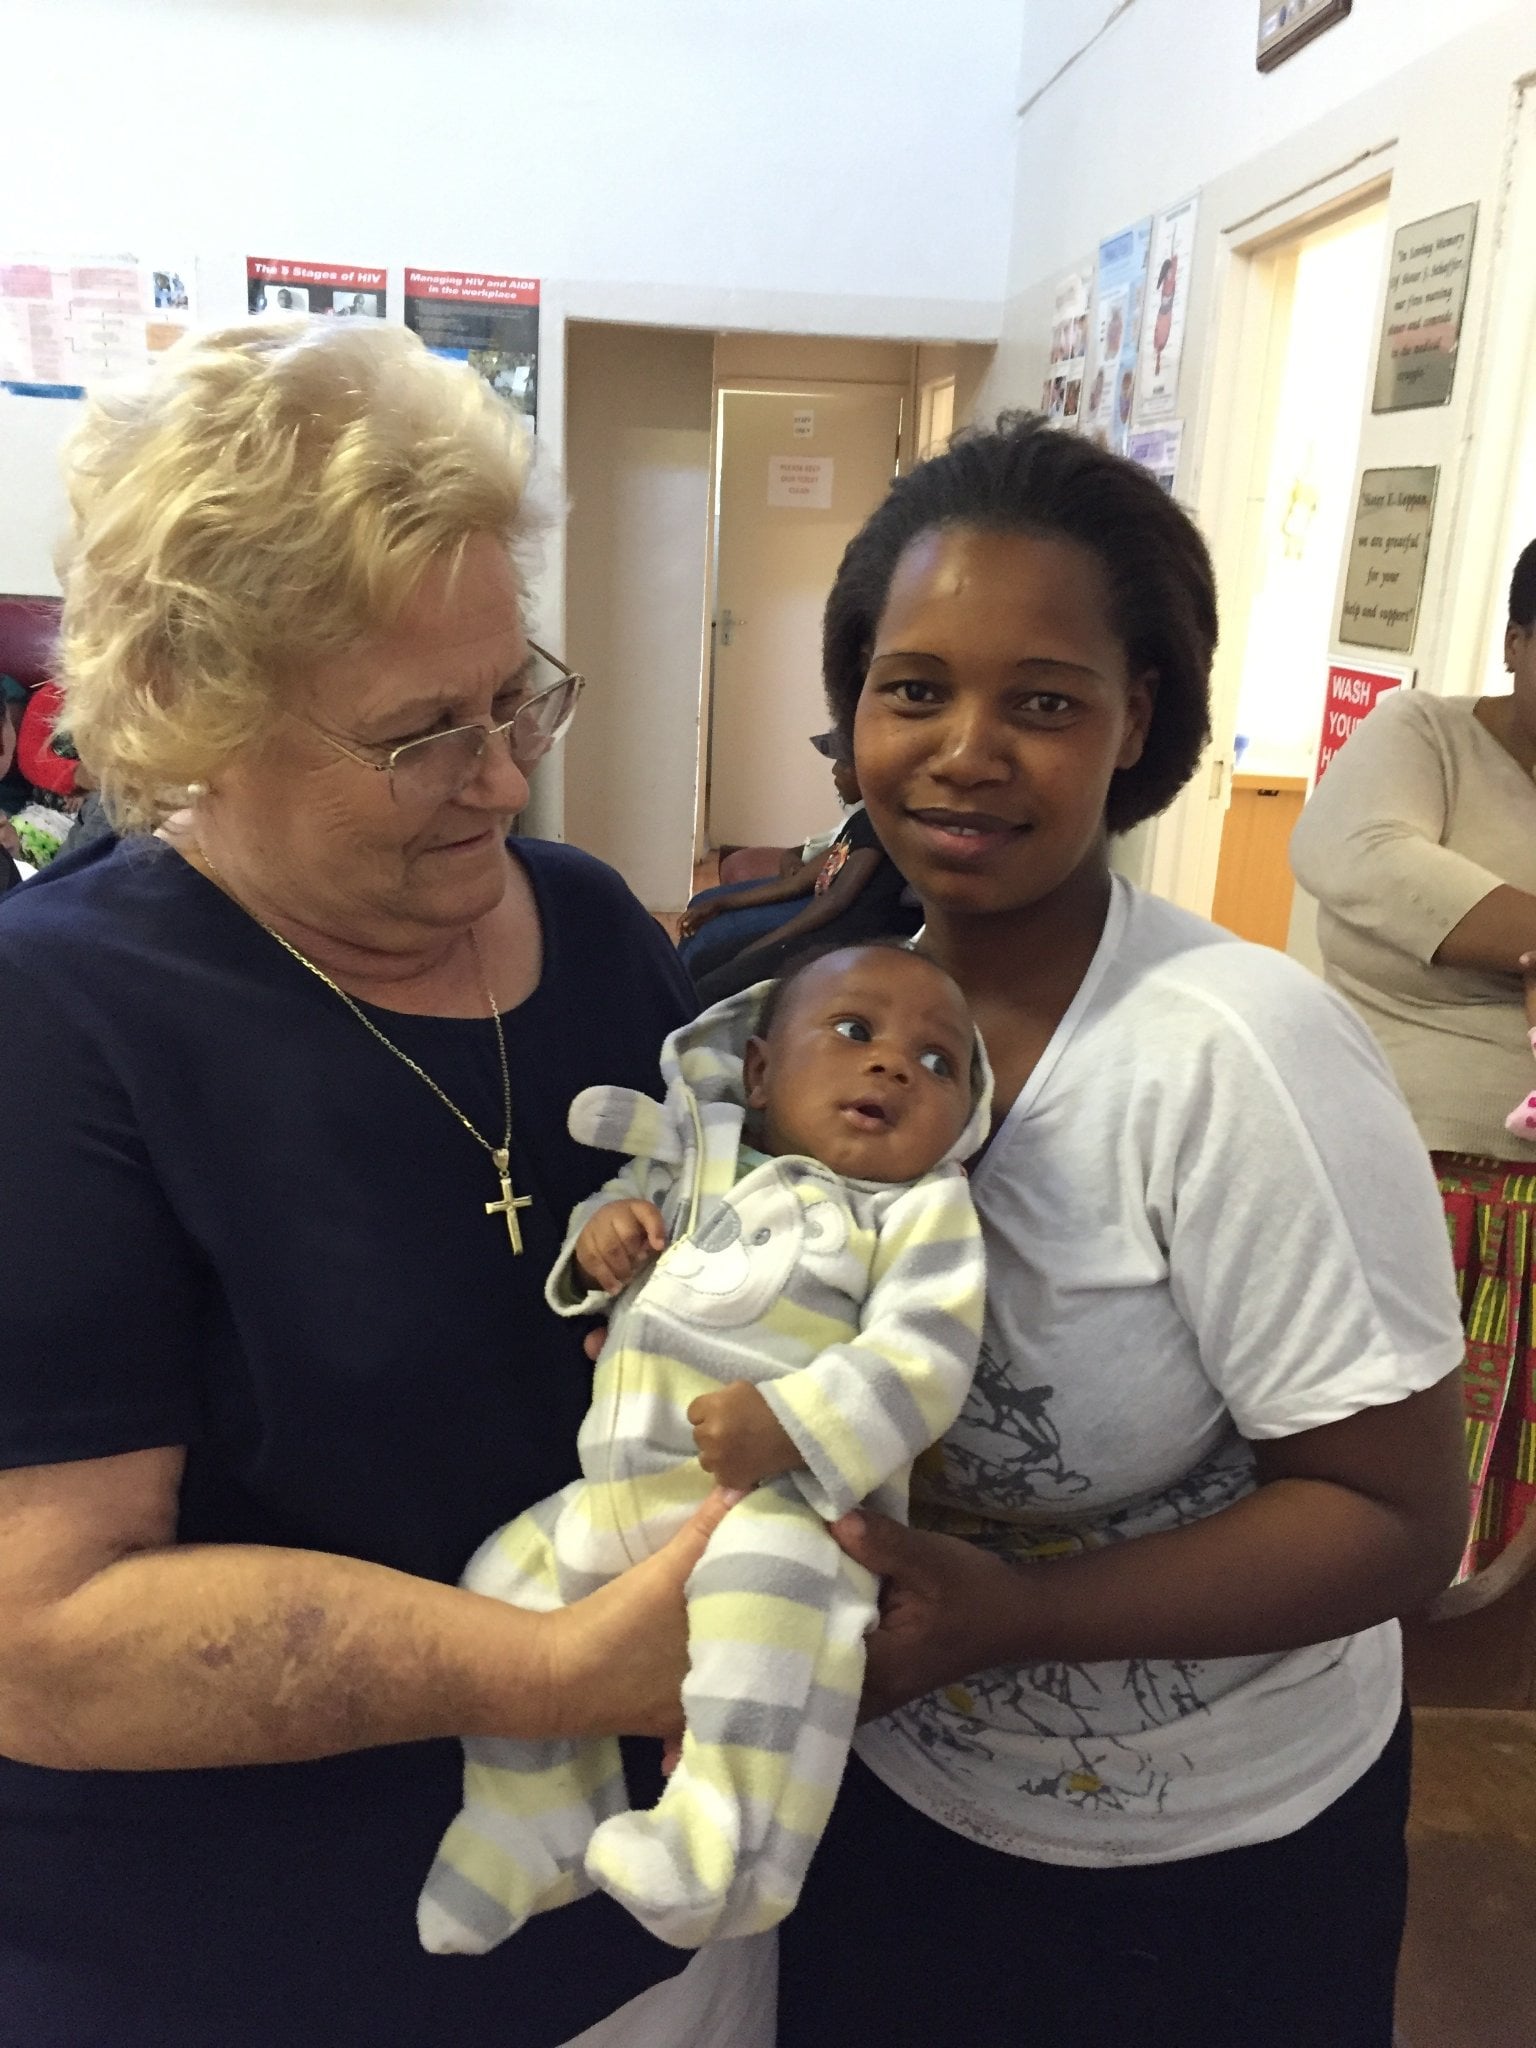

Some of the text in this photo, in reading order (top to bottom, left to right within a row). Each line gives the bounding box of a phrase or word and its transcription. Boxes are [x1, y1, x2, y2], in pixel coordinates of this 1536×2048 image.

[255, 263, 381, 283] The 5 Stages of HIV
[410, 273, 536, 290] Managing HIV and AIDS
[428, 285, 517, 299] in the workplace
[1365, 566, 1400, 589] for your
[1361, 604, 1378, 618] and
[1333, 675, 1371, 707] WASH
[1329, 710, 1362, 739] YOU
